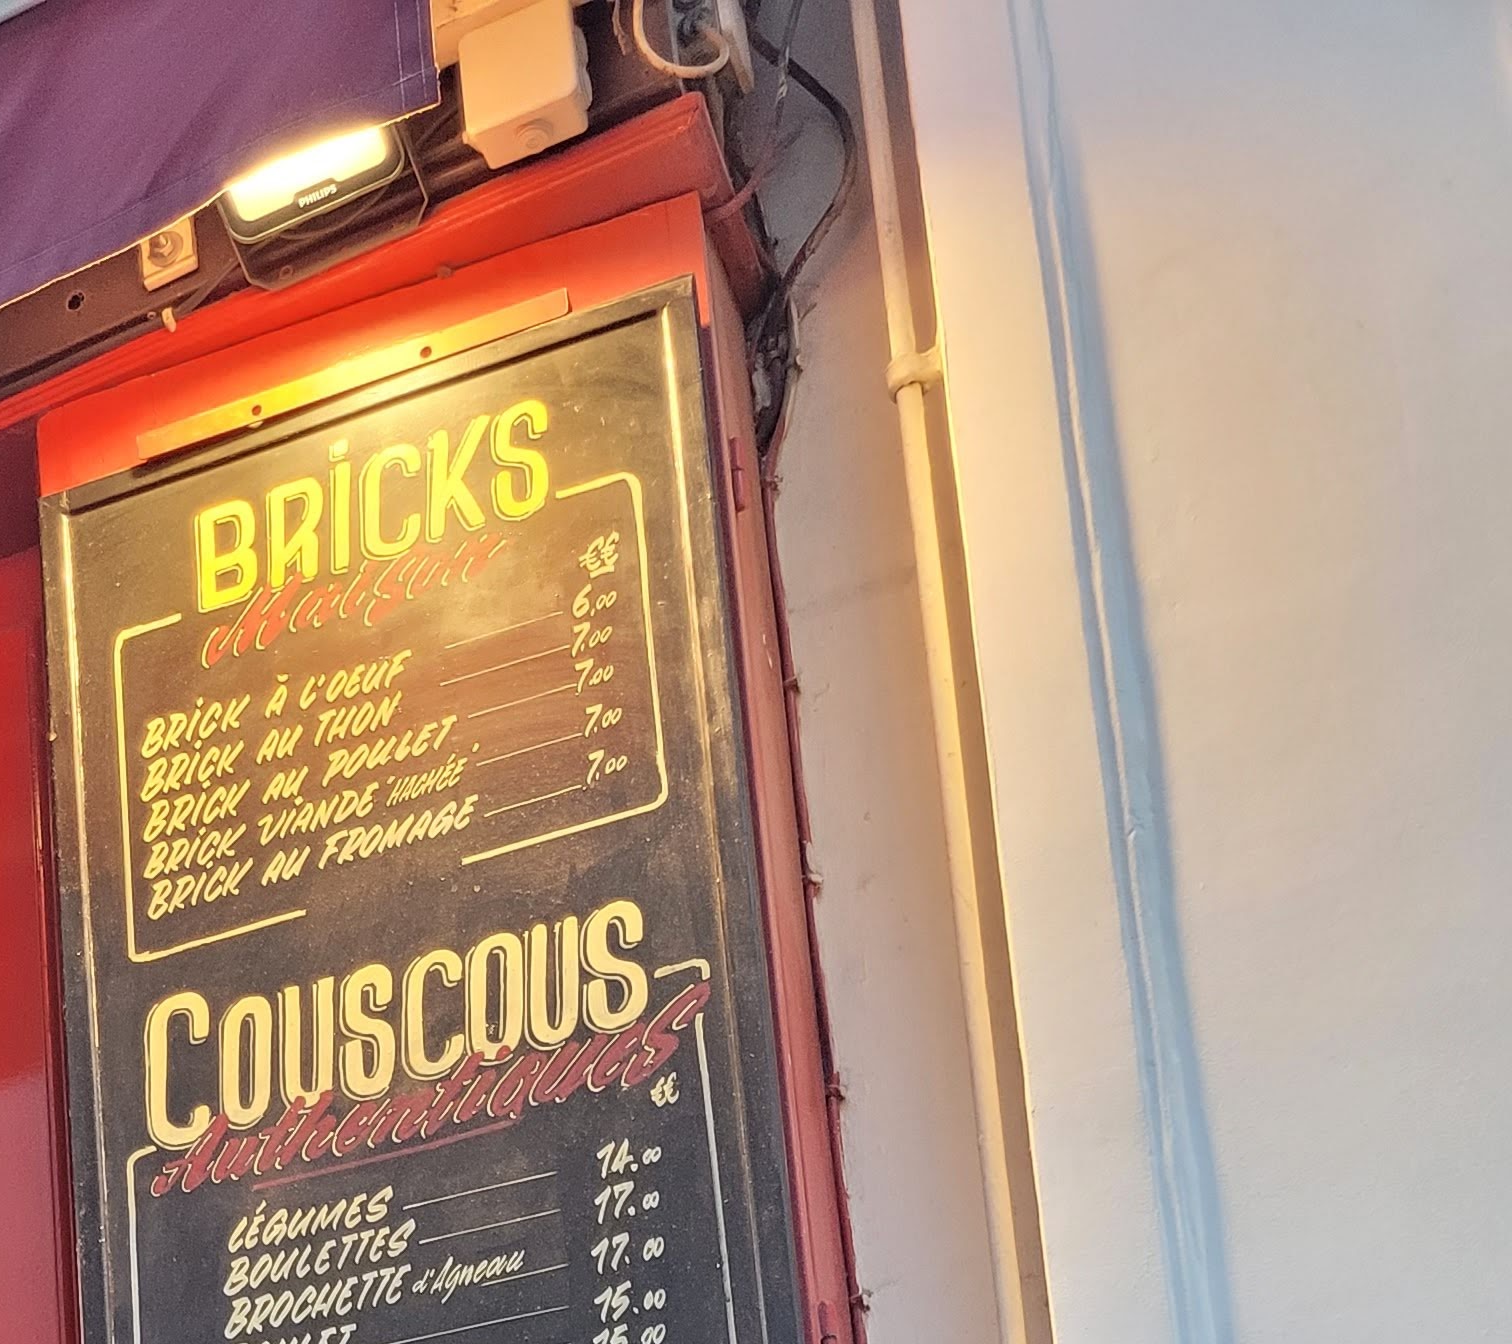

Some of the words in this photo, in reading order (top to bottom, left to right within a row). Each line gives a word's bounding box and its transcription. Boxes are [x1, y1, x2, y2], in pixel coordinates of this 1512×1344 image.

[298, 183, 337, 208] PHILIPS
[299, 649, 413, 711] L'OEUF
[256, 724, 303, 764] AU
[314, 690, 402, 747] THON
[262, 766, 309, 805] AU
[322, 715, 458, 788] POULET
[261, 846, 311, 886] AU
[318, 794, 479, 870] FROMAGE
[144, 900, 649, 1150] COUSCOUS
[150, 981, 711, 1197] Authentiques
[223, 1218, 416, 1296] BOULETTES
[594, 1181, 660, 1224] 17.00
[228, 1185, 393, 1253] LÉGUMES
[596, 1138, 662, 1178] 14.00
[223, 1264, 412, 1339] BROCHETTE
[412, 1250, 526, 1304] d'Agneau
[594, 1281, 666, 1323] 15.00
